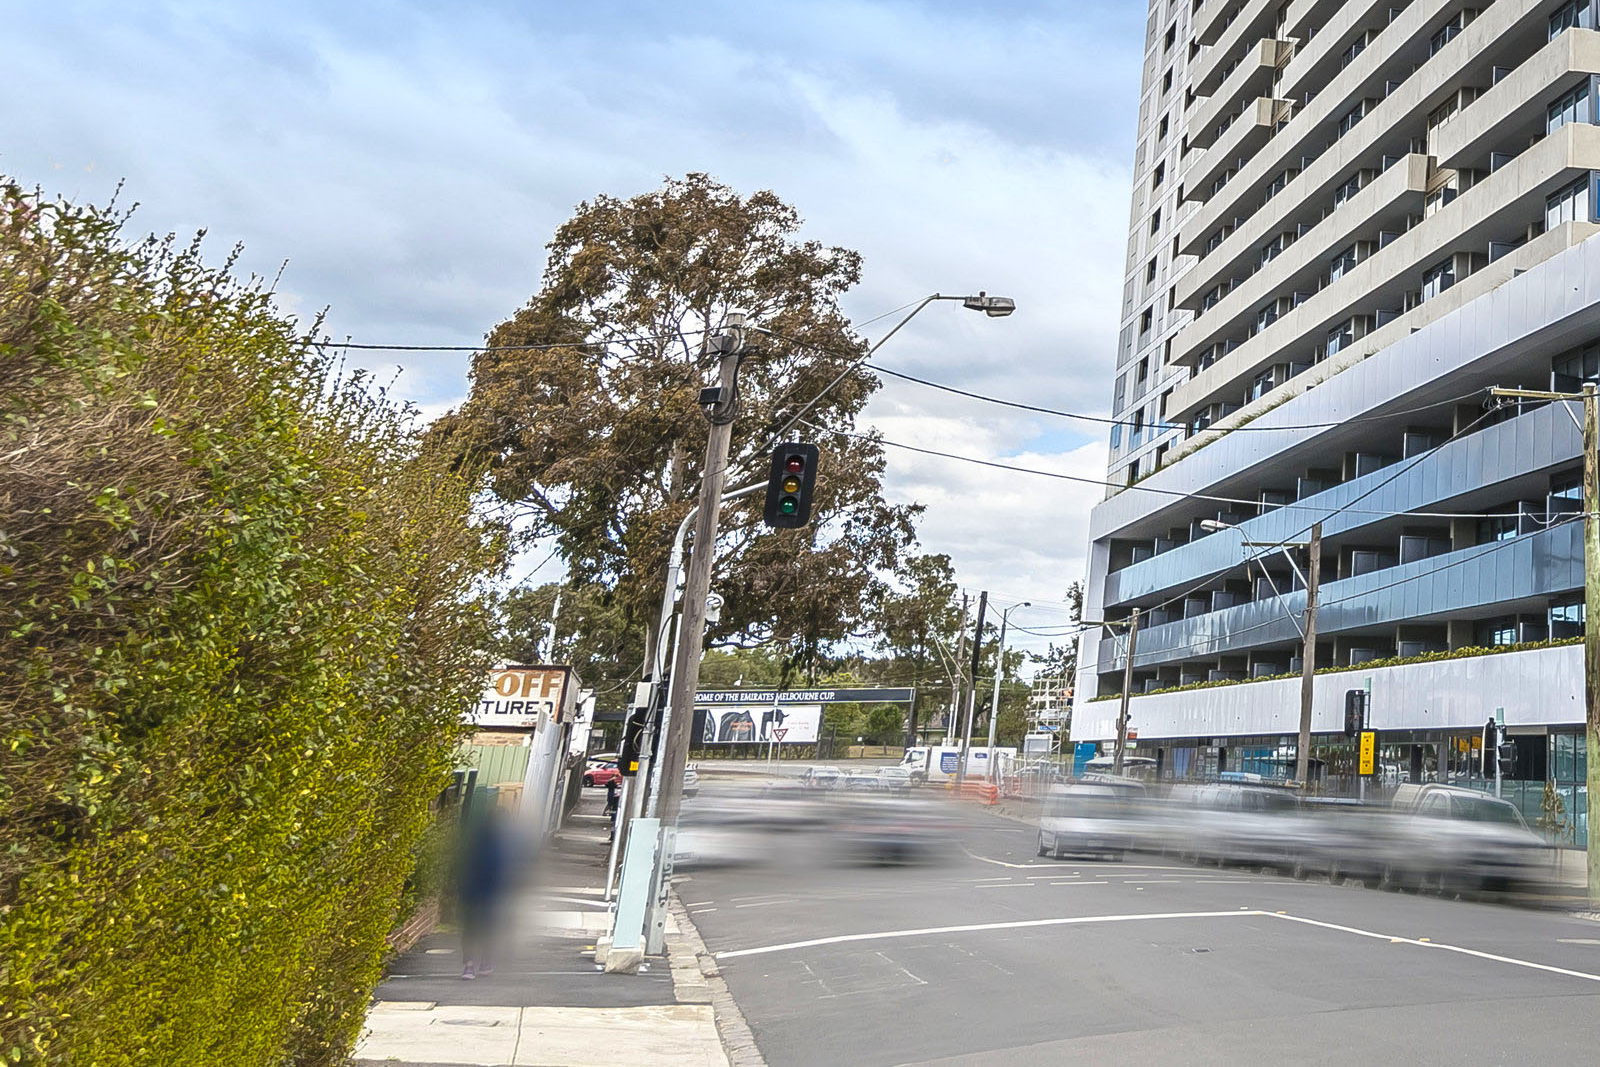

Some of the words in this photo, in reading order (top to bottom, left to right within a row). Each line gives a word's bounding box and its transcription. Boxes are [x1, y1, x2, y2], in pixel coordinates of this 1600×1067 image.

[496, 673, 561, 697] OFF
[714, 693, 725, 701] OF
[725, 693, 739, 701] THE
[740, 692, 774, 701] EMIRATES
[776, 692, 819, 701] MELBOURNE
[819, 691, 836, 701] CUP.
[470, 700, 540, 715] ITURE
